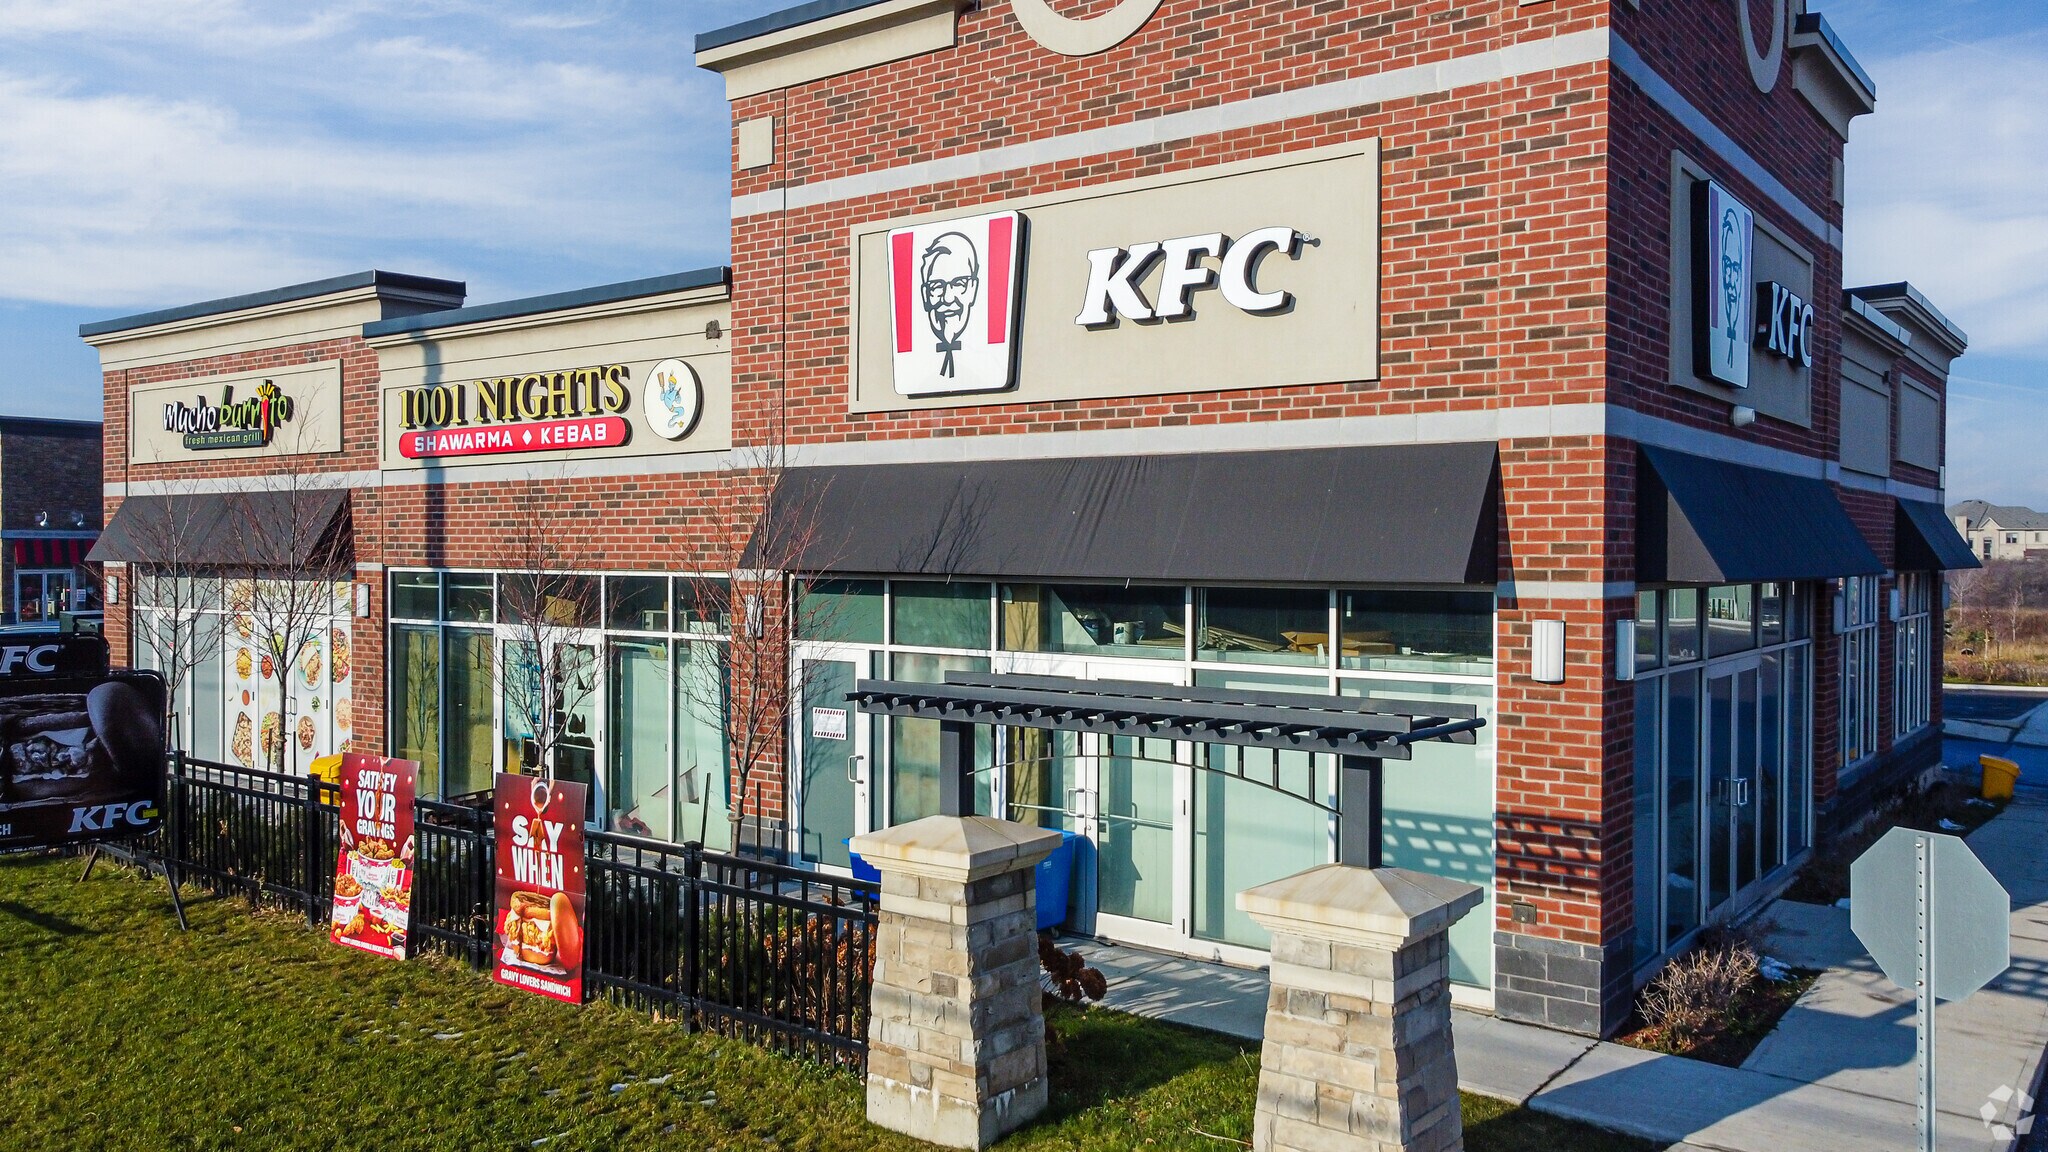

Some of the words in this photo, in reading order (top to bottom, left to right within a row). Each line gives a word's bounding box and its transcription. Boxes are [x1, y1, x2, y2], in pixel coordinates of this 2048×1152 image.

[1074, 226, 1298, 328] KFC
[1768, 281, 1814, 368] KFC
[398, 384, 464, 428] 1001
[474, 364, 628, 422] NIGHTS
[185, 436, 206, 445] fresh
[208, 434, 241, 443] mexican
[243, 432, 261, 443] grill
[415, 429, 513, 452] SHAWARMA
[541, 423, 607, 444] KEBAB
[0, 644, 59, 674] FC
[67, 800, 152, 834] KFC
[512, 815, 564, 853] SAY
[511, 845, 564, 891] WHEN
[500, 968, 519, 983] GRAVY
[520, 973, 541, 989] LOVERS
[540, 979, 571, 998] SANDWICH
